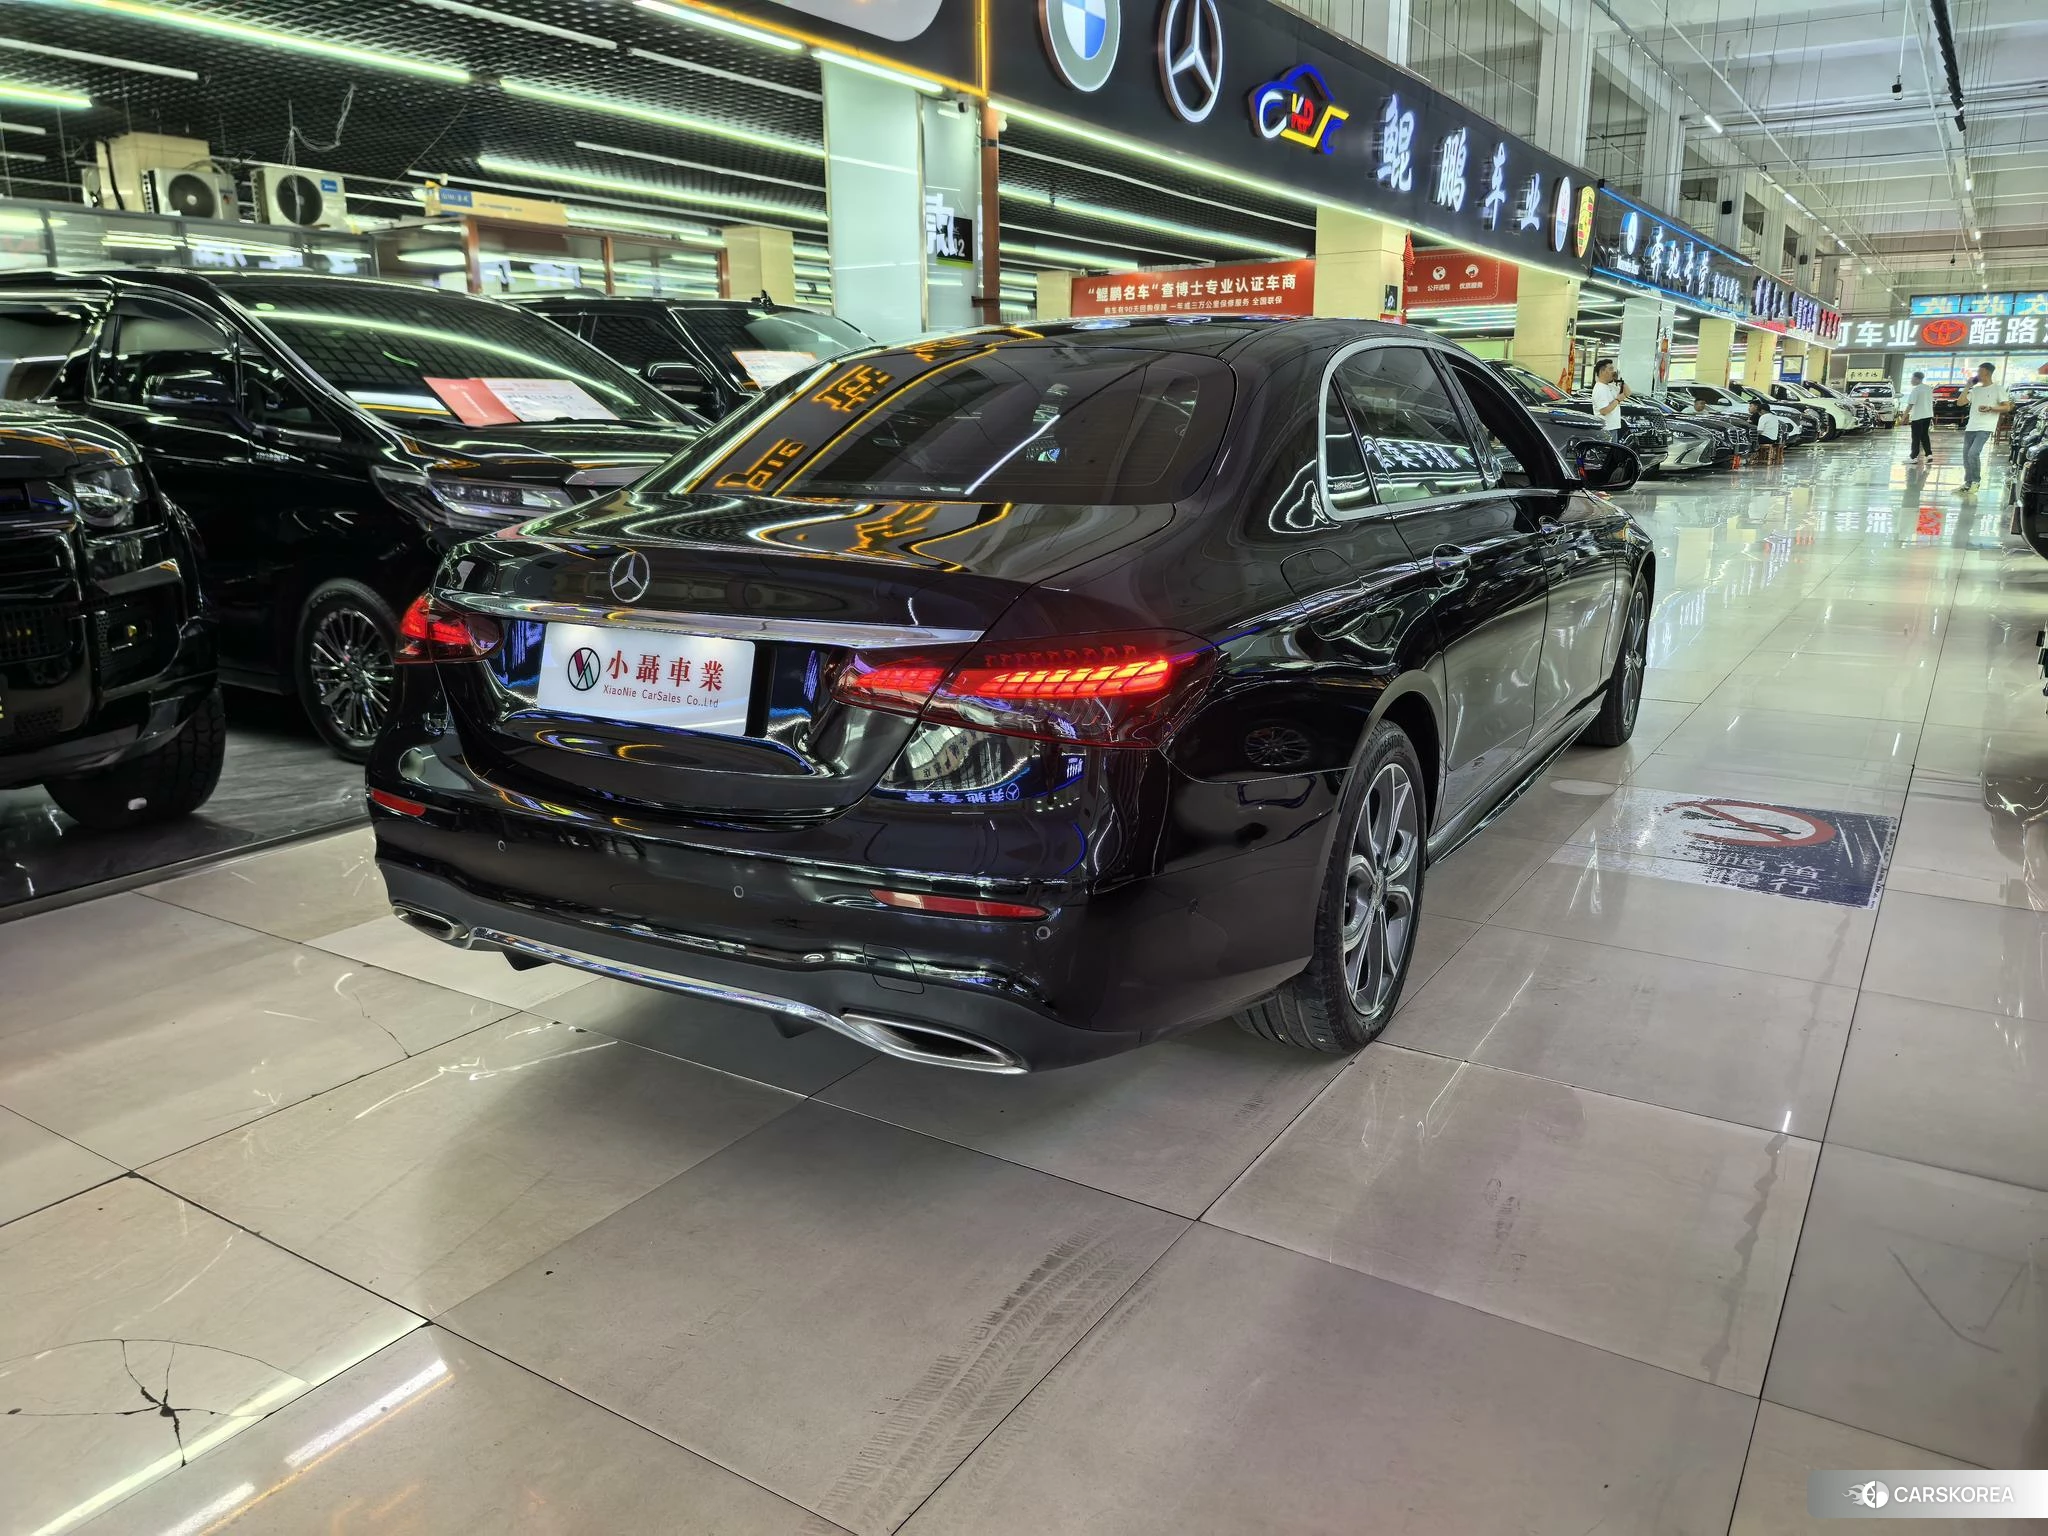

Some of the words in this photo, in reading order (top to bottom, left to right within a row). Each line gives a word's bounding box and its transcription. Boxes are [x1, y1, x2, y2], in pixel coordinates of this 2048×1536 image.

[1968, 316, 2048, 345] 酷路
[606, 650, 724, 692] 小聶車業
[603, 684, 637, 698] XiaoNie
[642, 689, 681, 704] CarSales
